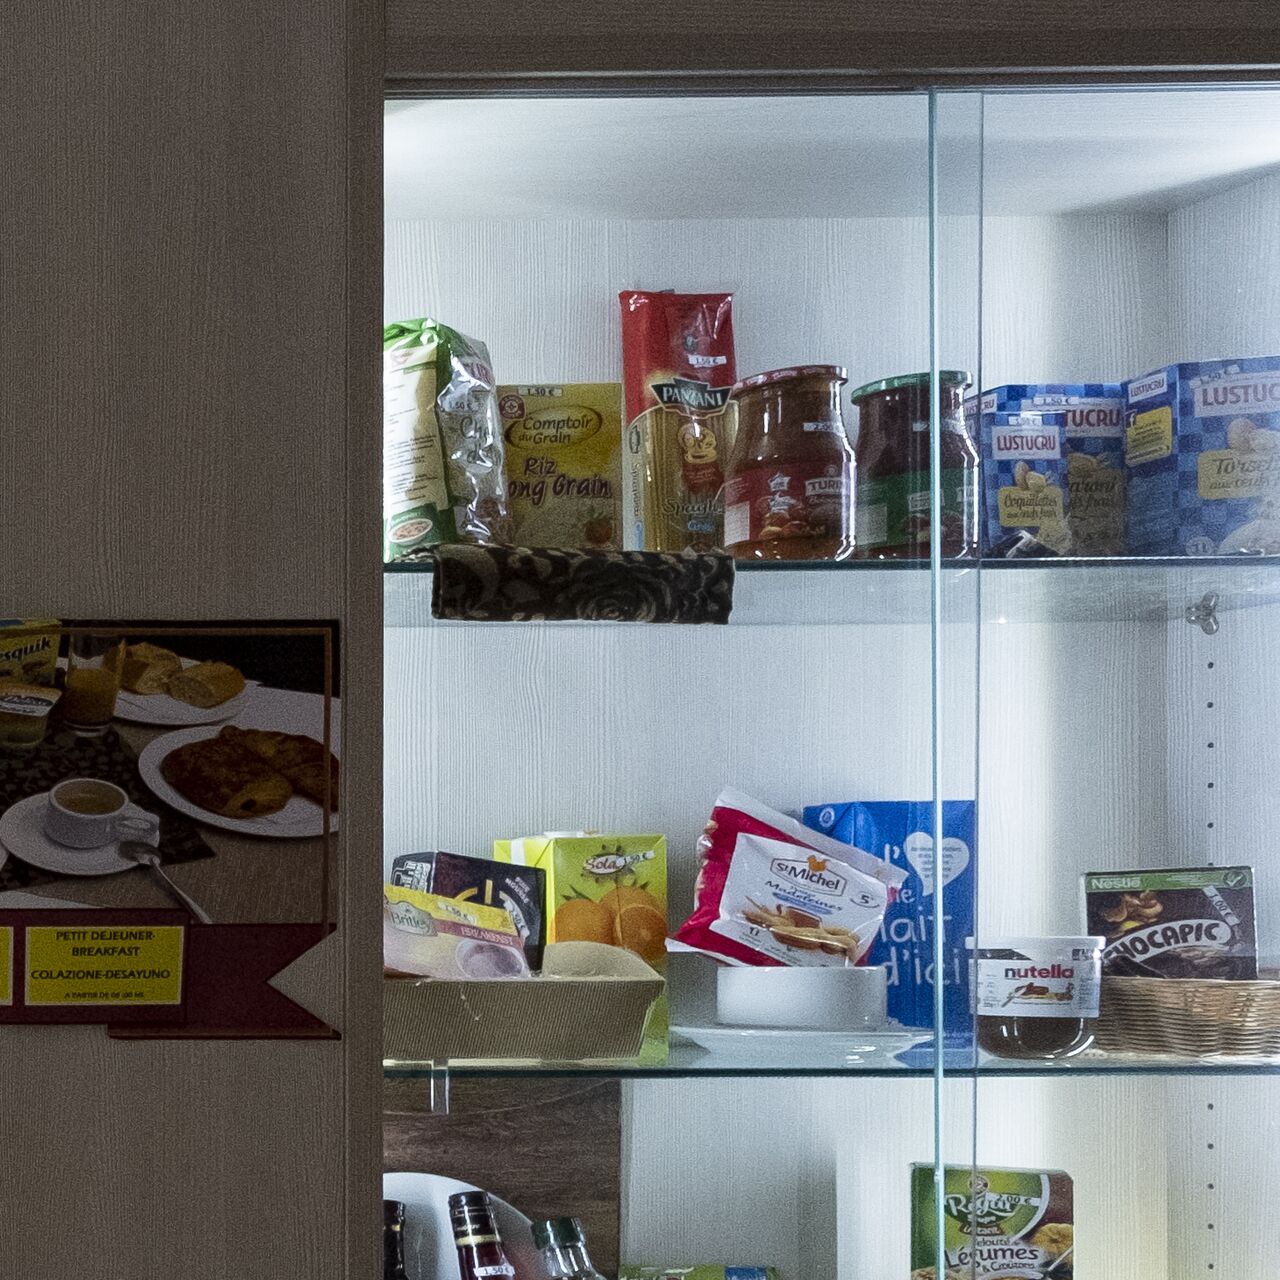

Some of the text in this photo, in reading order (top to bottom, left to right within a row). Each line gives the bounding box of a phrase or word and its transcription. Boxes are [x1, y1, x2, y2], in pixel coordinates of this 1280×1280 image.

[661, 387, 723, 406] PANZANI
[1129, 378, 1165, 397] LUSTUCRU
[522, 413, 593, 433] Comptoir
[532, 430, 571, 444] Grain
[996, 434, 1057, 451] LUSTUCRU
[523, 456, 557, 476] Riz
[552, 474, 612, 498] Grain
[789, 864, 841, 891] Michel
[56, 930, 87, 941] PETIT
[71, 947, 141, 957] BREAKFAST
[1004, 963, 1075, 979] nutella
